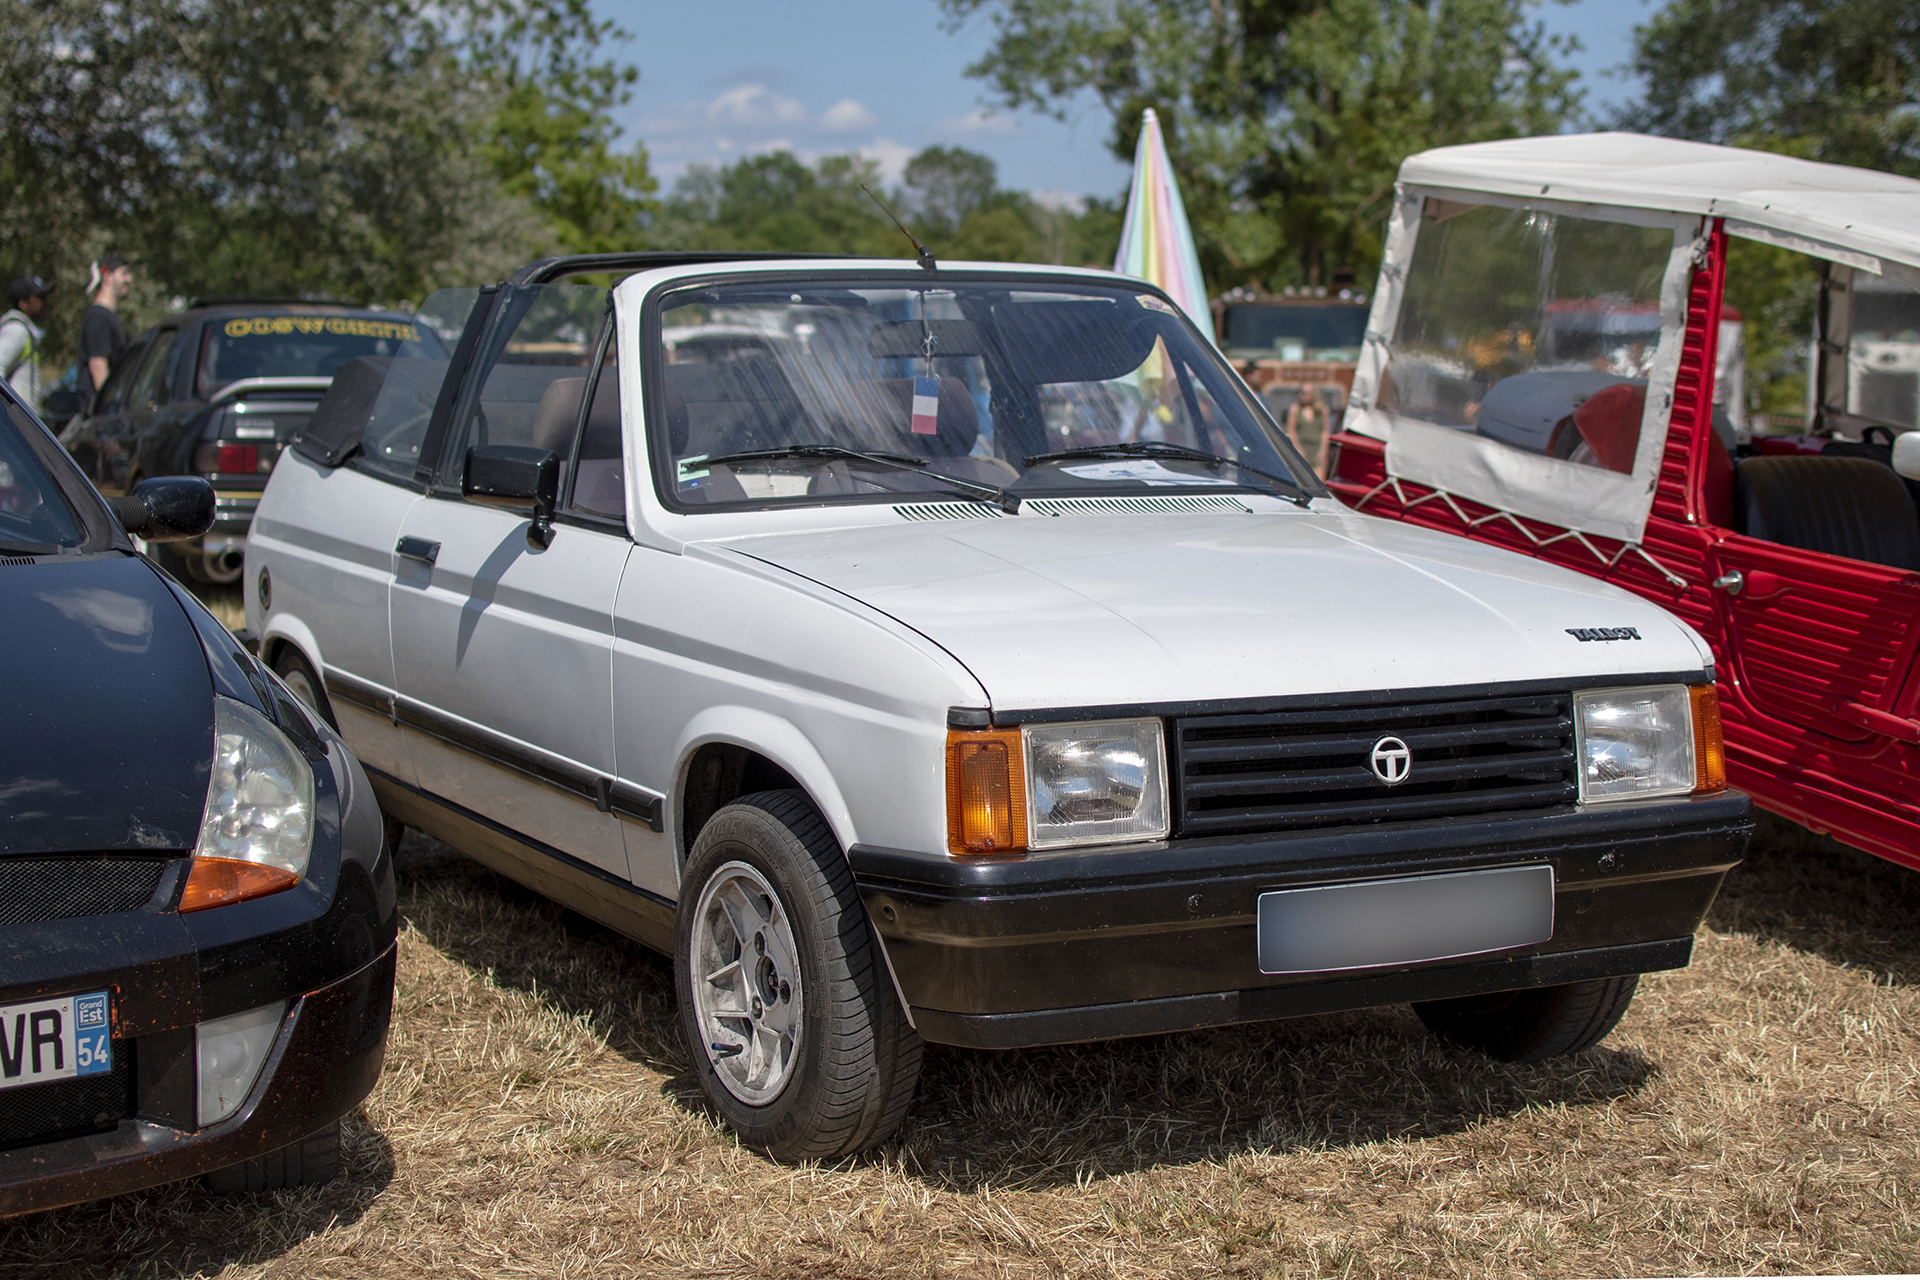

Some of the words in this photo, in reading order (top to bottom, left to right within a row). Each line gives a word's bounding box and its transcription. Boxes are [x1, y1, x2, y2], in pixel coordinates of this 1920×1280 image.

[1565, 627, 1642, 642] TALBOT
[79, 1000, 103, 1010] Grand
[80, 1008, 103, 1023] Est
[0, 1009, 64, 1078] VR
[78, 1035, 108, 1067] 54
